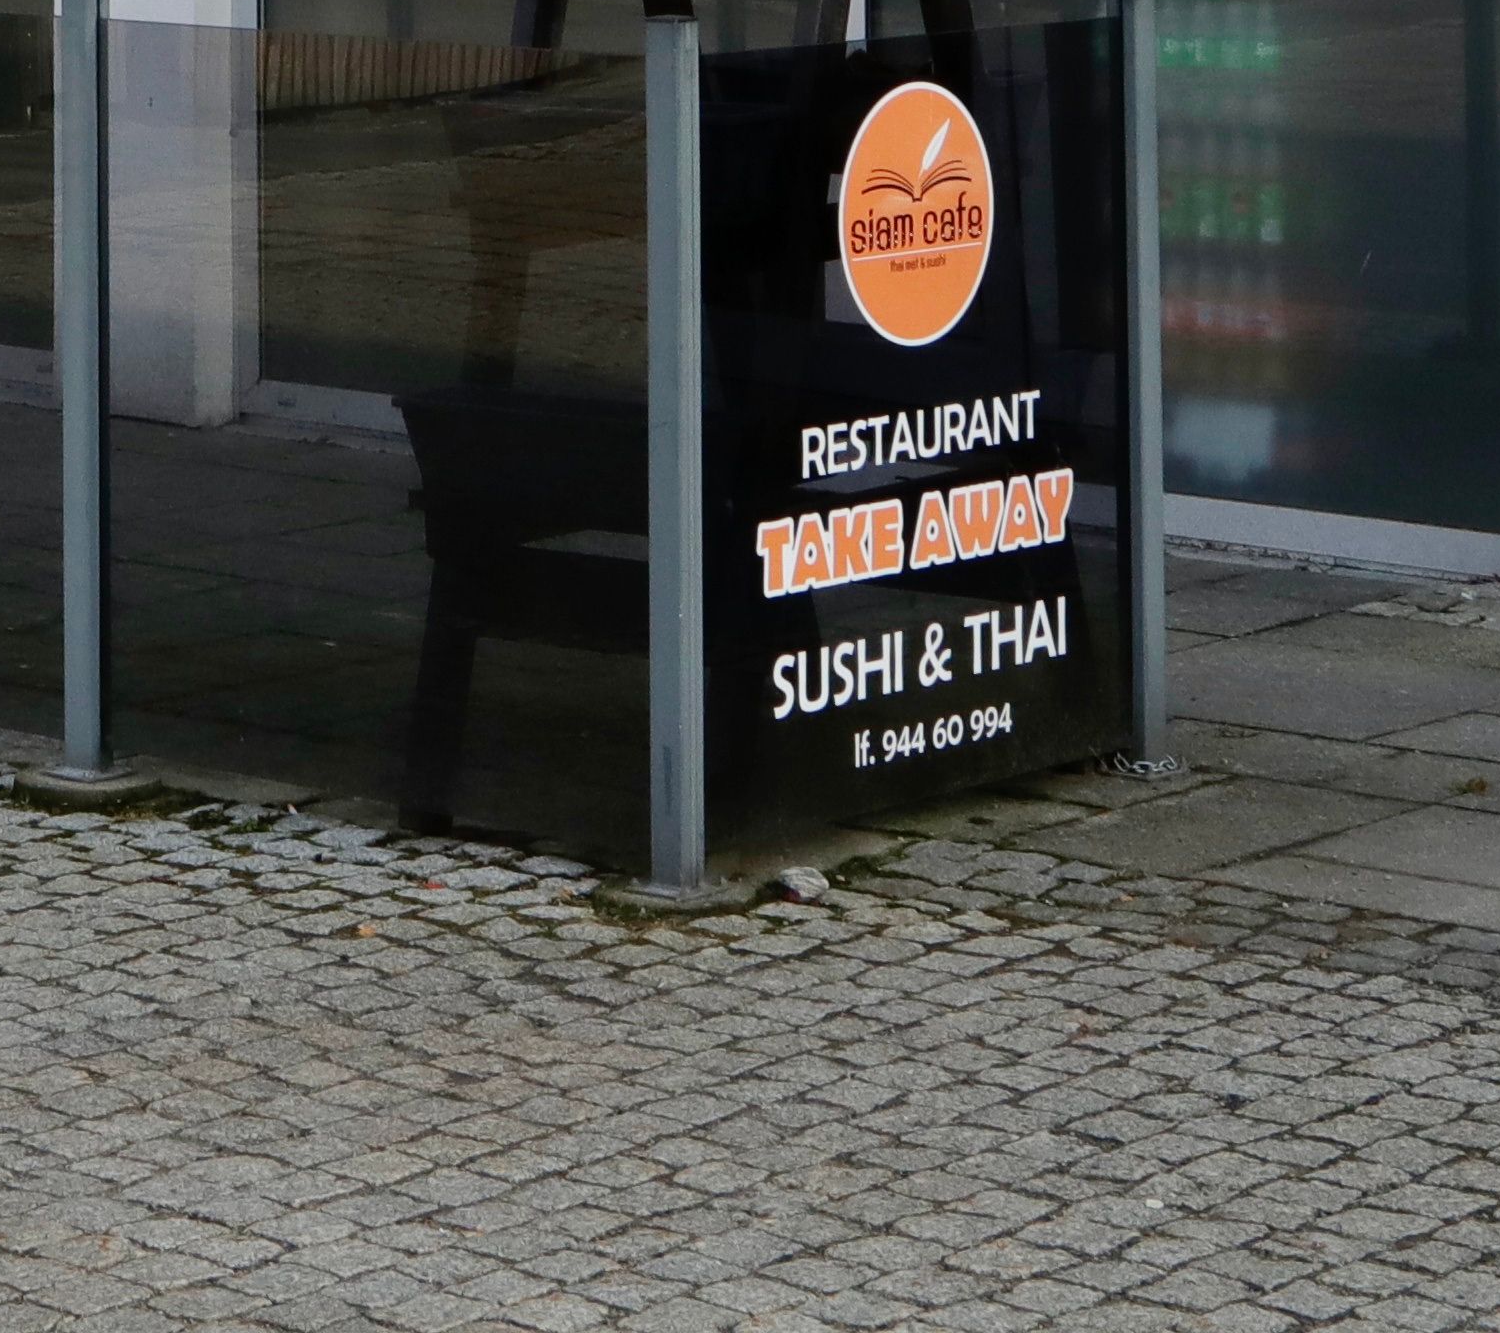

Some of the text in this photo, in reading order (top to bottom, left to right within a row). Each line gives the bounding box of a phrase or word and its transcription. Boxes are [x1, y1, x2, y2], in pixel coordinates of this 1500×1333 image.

[850, 190, 983, 255] siam cafe
[801, 388, 1041, 480] RESTAURANT
[756, 467, 1075, 599] TAKE AWAY
[772, 595, 1068, 721] SUSHI & THAI
[881, 721, 926, 763] 944
[932, 713, 964, 750] 60
[969, 701, 1013, 742] 994
